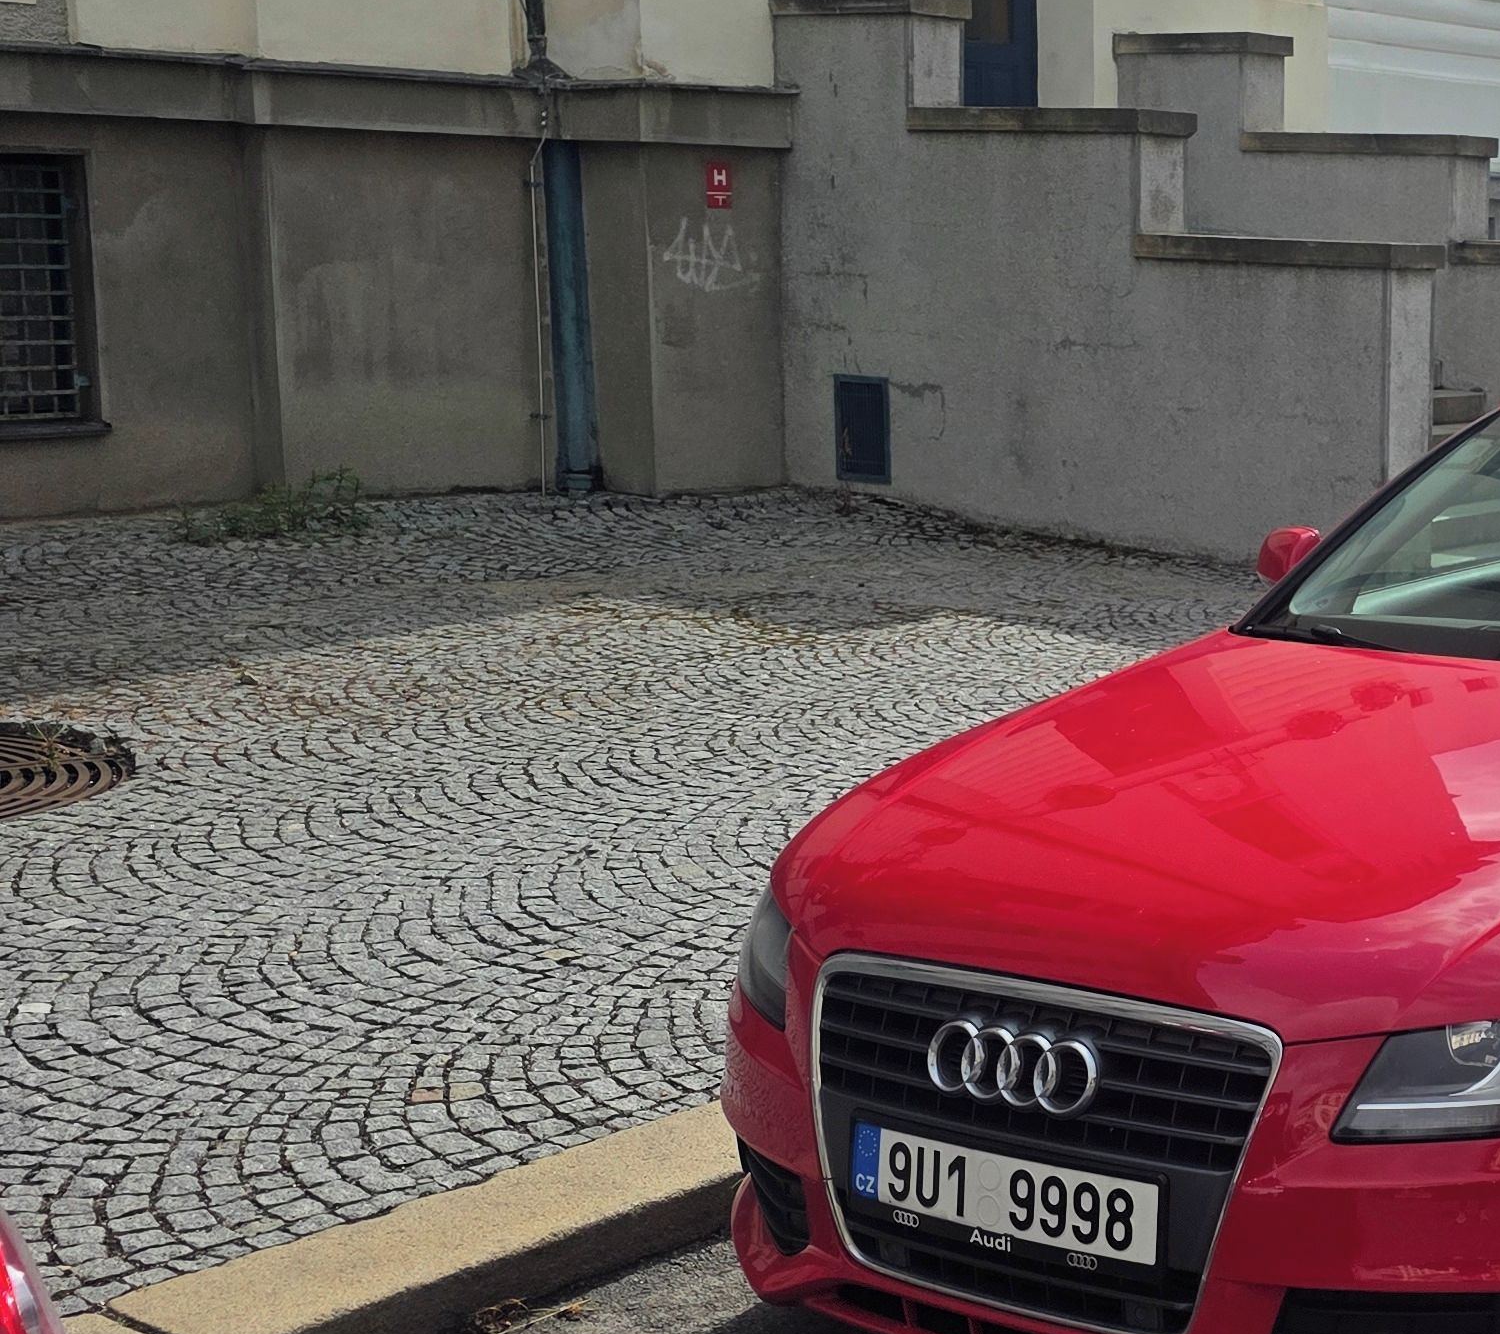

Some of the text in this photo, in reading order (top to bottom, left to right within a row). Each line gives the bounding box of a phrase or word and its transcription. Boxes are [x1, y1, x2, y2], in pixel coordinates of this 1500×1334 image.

[714, 169, 726, 185] H
[714, 196, 726, 205] T
[855, 1172, 875, 1194] CZ
[888, 1141, 1134, 1251] 9U1 9998
[969, 1228, 1011, 1253] Audi
